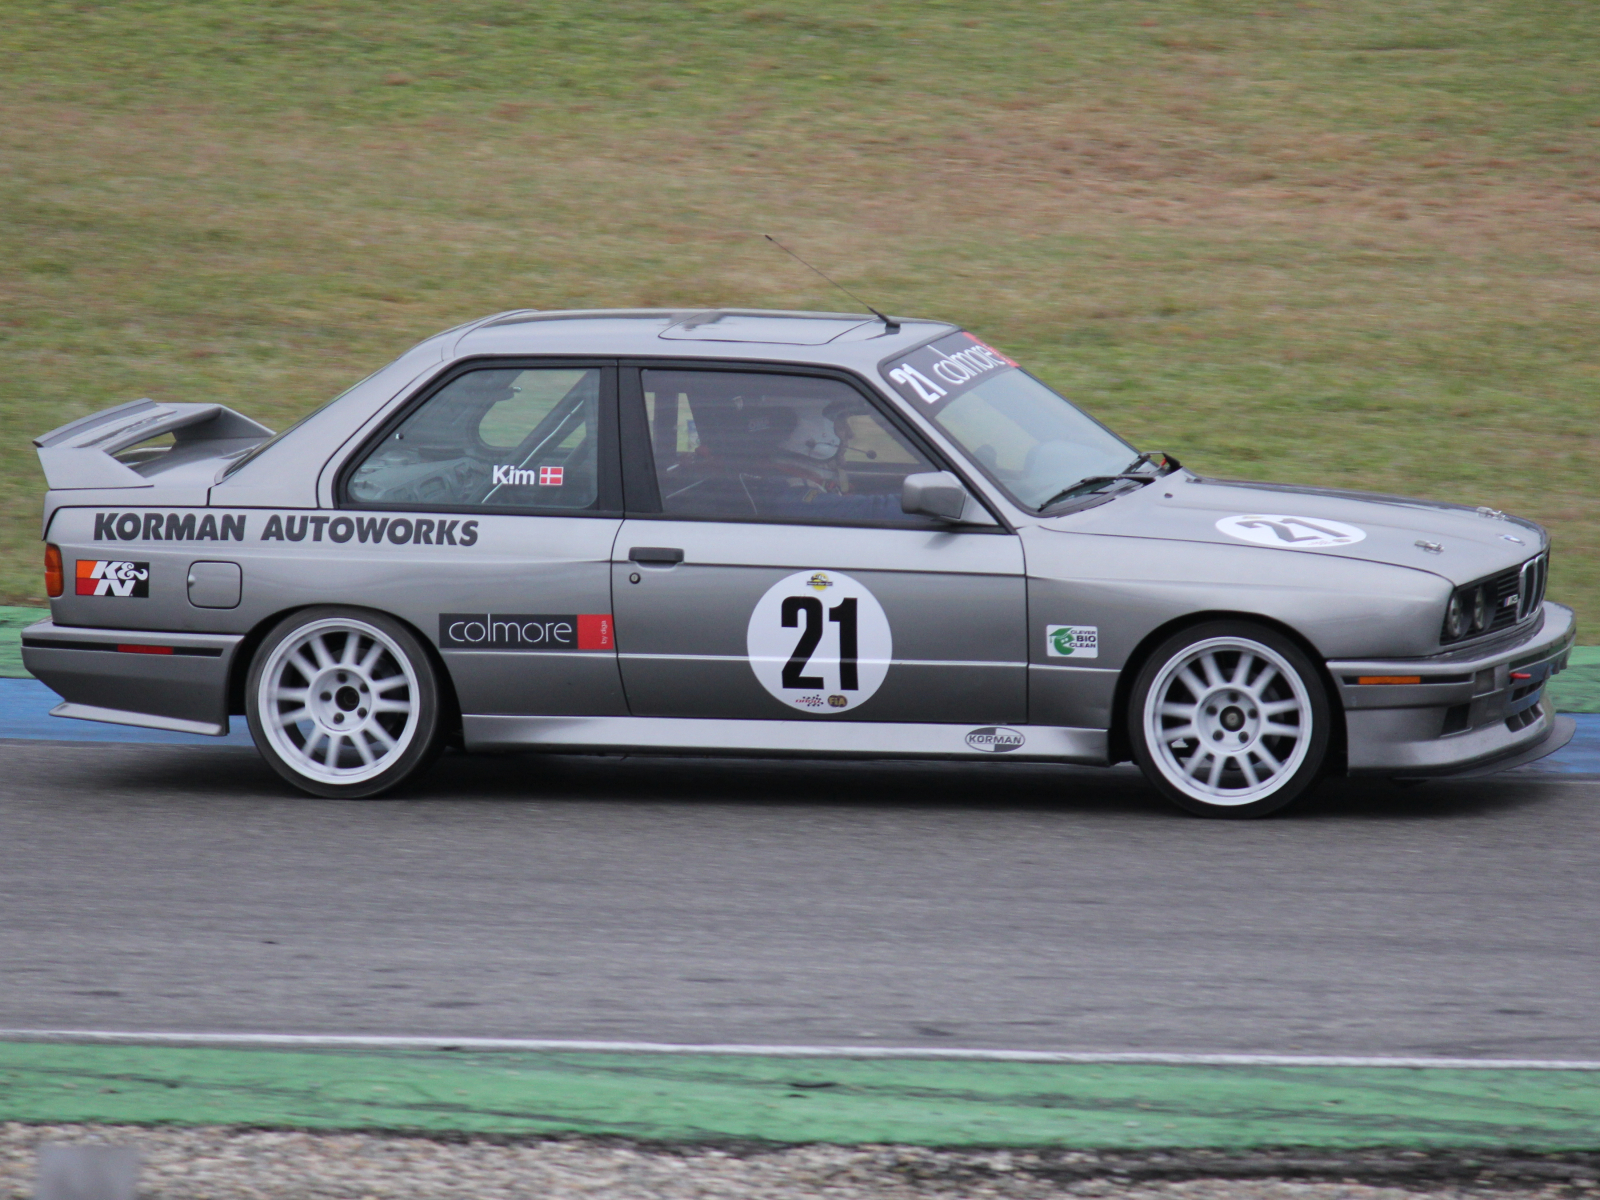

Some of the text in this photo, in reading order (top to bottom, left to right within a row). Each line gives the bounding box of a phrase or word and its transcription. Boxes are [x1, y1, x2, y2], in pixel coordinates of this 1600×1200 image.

[889, 363, 948, 404] 21
[926, 344, 1006, 384] colmore
[492, 465, 535, 485] Kim
[93, 512, 480, 547] KORMAN AUTOWORKS
[1235, 517, 1351, 543] 21
[448, 613, 573, 643] colmore
[781, 595, 859, 691] 21
[829, 696, 846, 707] FIA
[968, 735, 1022, 744] KORMAN
